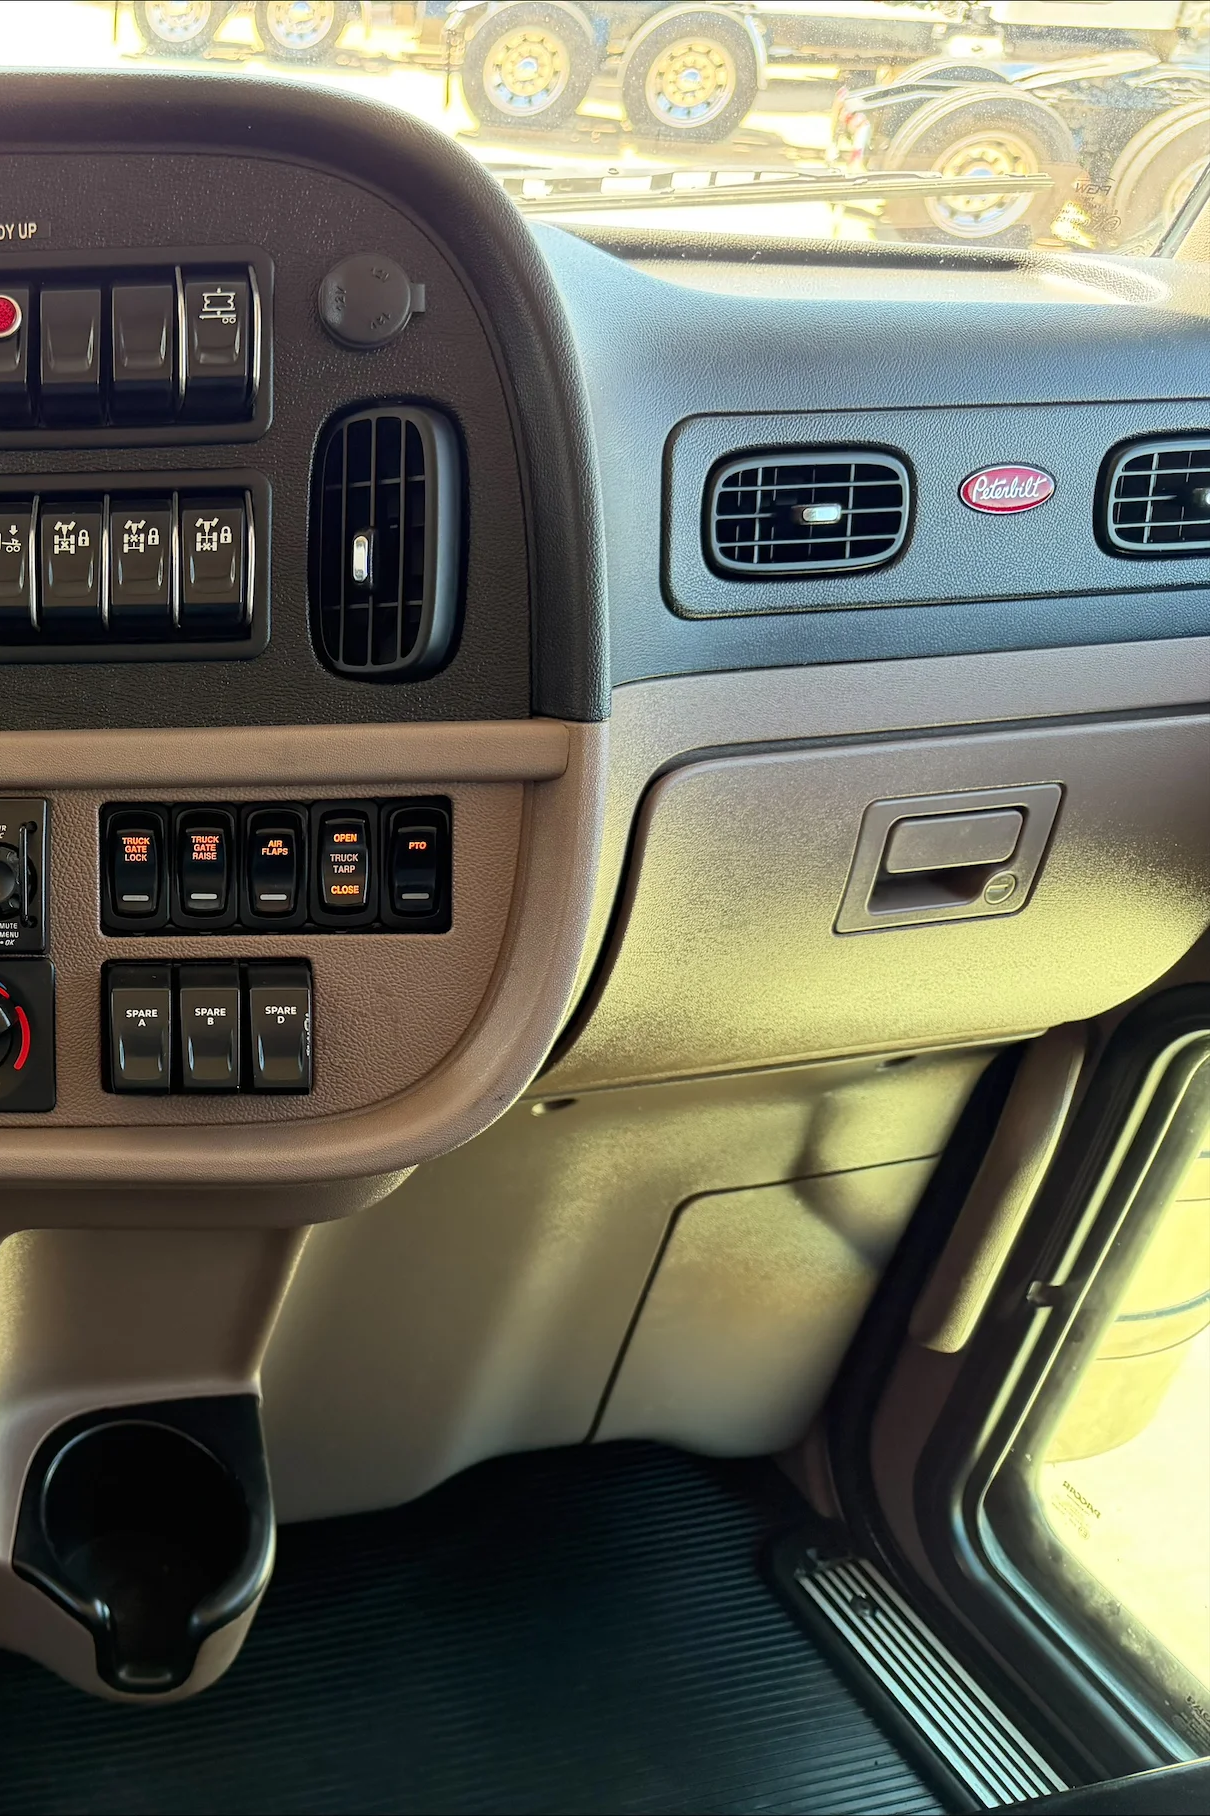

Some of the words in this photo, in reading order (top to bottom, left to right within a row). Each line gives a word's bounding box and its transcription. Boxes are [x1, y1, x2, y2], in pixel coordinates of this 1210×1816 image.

[18, 222, 38, 240] UP
[972, 476, 1047, 503] Peterbilt
[122, 837, 150, 845] TRUCK
[191, 835, 219, 844] TRUCK
[334, 834, 357, 843] OPEN
[194, 844, 216, 852] GATE
[267, 840, 283, 848] AIR
[409, 842, 427, 850] PTO
[125, 845, 148, 853] GATE
[262, 847, 288, 856] FLAPS
[124, 853, 147, 862] LOCK
[192, 852, 217, 860] RAISE
[330, 854, 358, 862] TRUCK
[333, 865, 355, 874] TARP
[330, 885, 360, 894] CLOSE
[126, 1009, 158, 1018] SPARE
[194, 1007, 226, 1017] SPARE
[265, 1006, 297, 1015] SPARE
[138, 1019, 146, 1027] A
[208, 1017, 214, 1026] B
[277, 1016, 285, 1024] D
